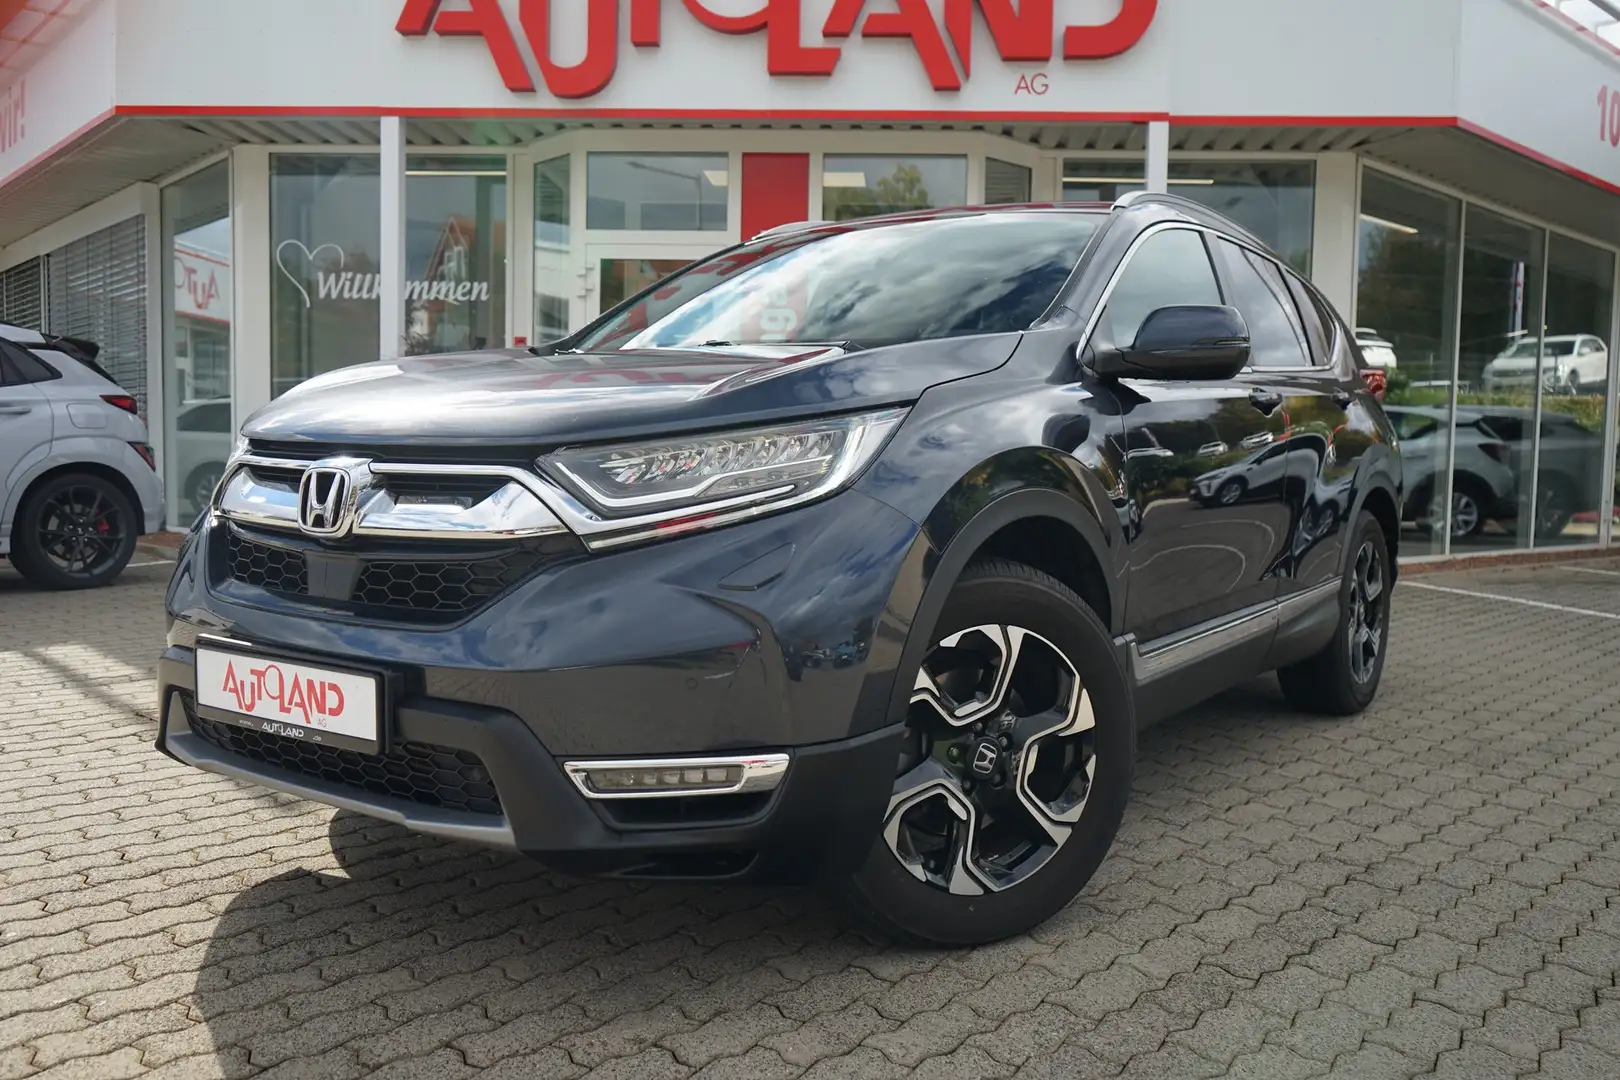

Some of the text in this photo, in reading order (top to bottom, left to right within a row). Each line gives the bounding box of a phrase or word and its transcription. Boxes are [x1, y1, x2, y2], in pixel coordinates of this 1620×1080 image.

[395, 0, 1157, 98] AULAND
[1014, 73, 1049, 96] AG
[316, 271, 489, 302] Willkmmen
[222, 660, 344, 724] AUTOLAND
[262, 722, 304, 737] AUTOLAND
[317, 717, 328, 729] AG
